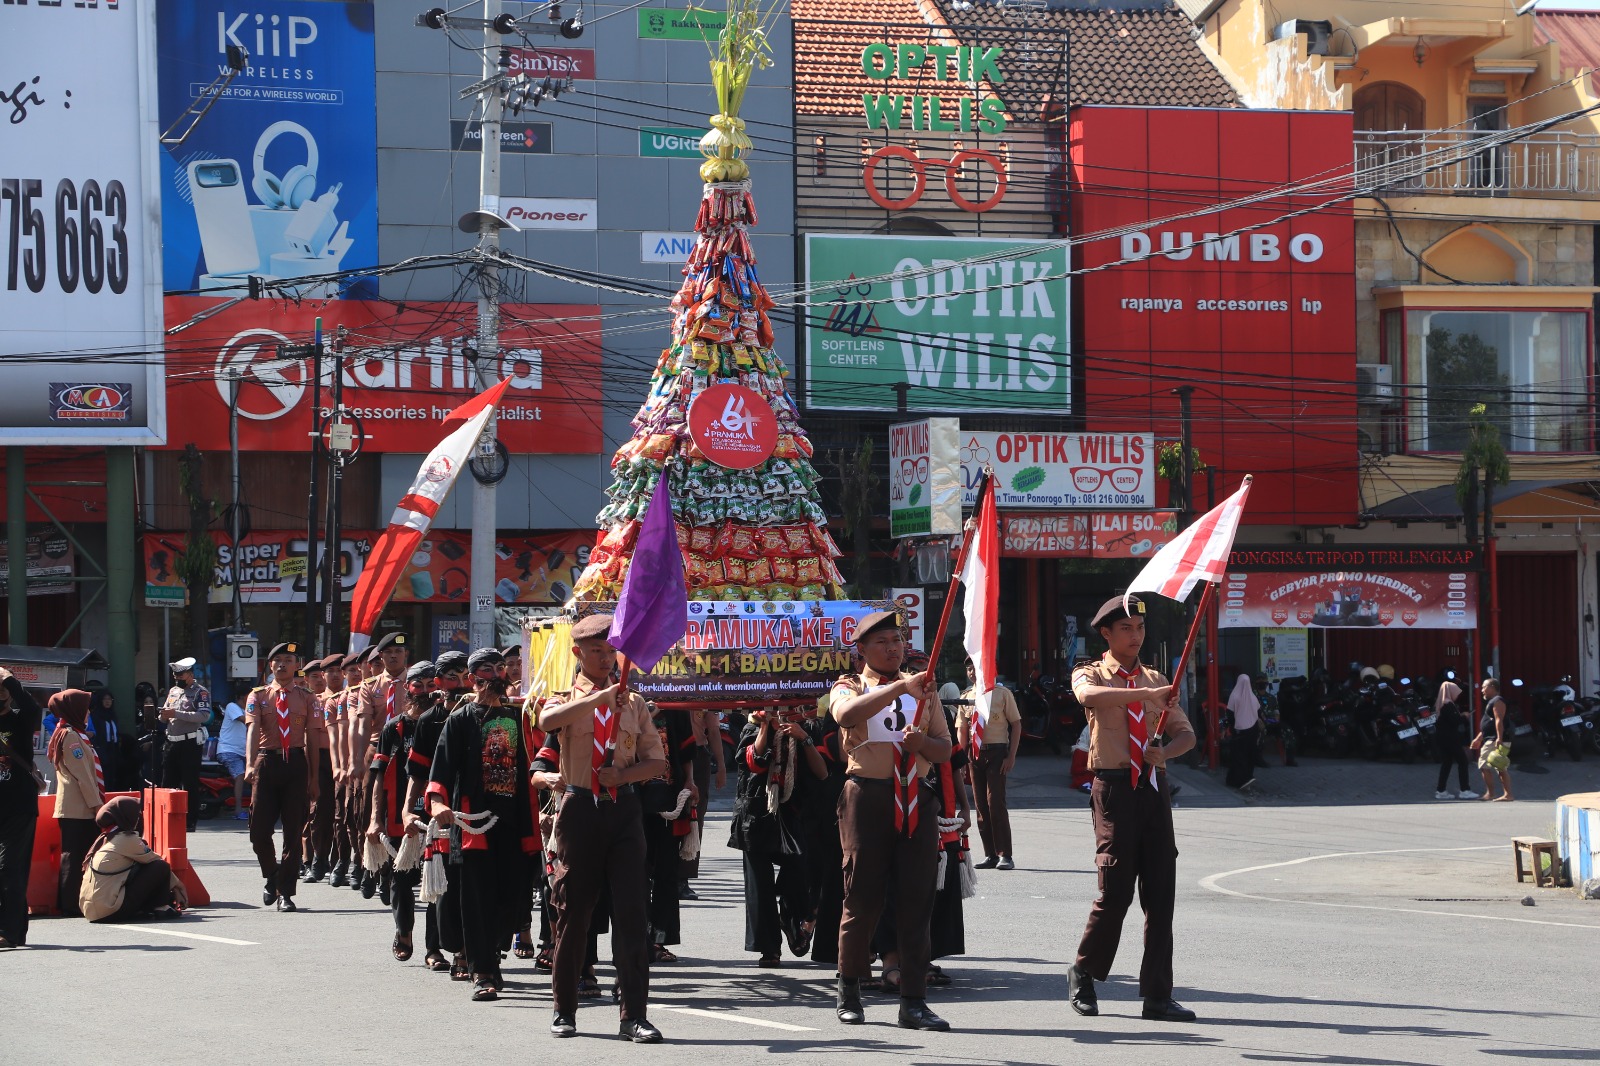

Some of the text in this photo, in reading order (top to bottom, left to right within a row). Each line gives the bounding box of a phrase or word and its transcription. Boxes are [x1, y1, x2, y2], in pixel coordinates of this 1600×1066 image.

[217, 11, 318, 58] KiiP
[509, 53, 581, 72] SanDisk
[861, 43, 1005, 83] OPTIK
[200, 87, 337, 101] POWER FOR A WIRELESS WORLD
[862, 94, 1006, 134] WILIS
[506, 206, 588, 222] Pioneer
[56, 178, 128, 295] 663
[1120, 231, 1324, 263] DUMBO
[890, 257, 1055, 318] OPTIK
[1121, 297, 1322, 314] rajanya accesories hp
[821, 339, 885, 351] SOFTLENS
[828, 354, 878, 365] CENTER
[897, 332, 1057, 391] WILIS
[320, 405, 427, 420] acessories
[497, 406, 542, 420] cialist
[711, 430, 748, 440] PRAMUKA
[891, 423, 929, 458] OPTIK WILIS
[996, 434, 1145, 464] OPTIK WILIS
[1076, 476, 1098, 484] SOFTLENS
[1003, 493, 1024, 503] Timur
[1026, 493, 1062, 505] Ponorogo
[1064, 494, 1077, 506] Tlp
[1083, 494, 1096, 504] 081
[1098, 494, 1112, 504] 216
[1115, 494, 1129, 504] 000
[1131, 494, 1145, 505] 904
[1008, 516, 1069, 533] FRAME
[1073, 514, 1128, 532] MULAI
[1132, 514, 1154, 532] 50
[1004, 536, 1075, 551] SOFTLENS
[1306, 551, 1365, 565] TRIPOD
[1367, 550, 1474, 565] TERLENGKAP
[214, 561, 280, 586] Mrah
[1270, 572, 1423, 603] GEBYAR PROMO MERDEKA
[439, 620, 468, 630] SERVICE
[671, 615, 858, 650] RAMUKA KE 6
[439, 630, 453, 643] HP
[637, 652, 851, 675] MK N 1 BADEGAN
[698, 682, 723, 692] untuk
[724, 681, 778, 692] membangun
[779, 679, 824, 690] ketahanan
[884, 696, 906, 731] 3
